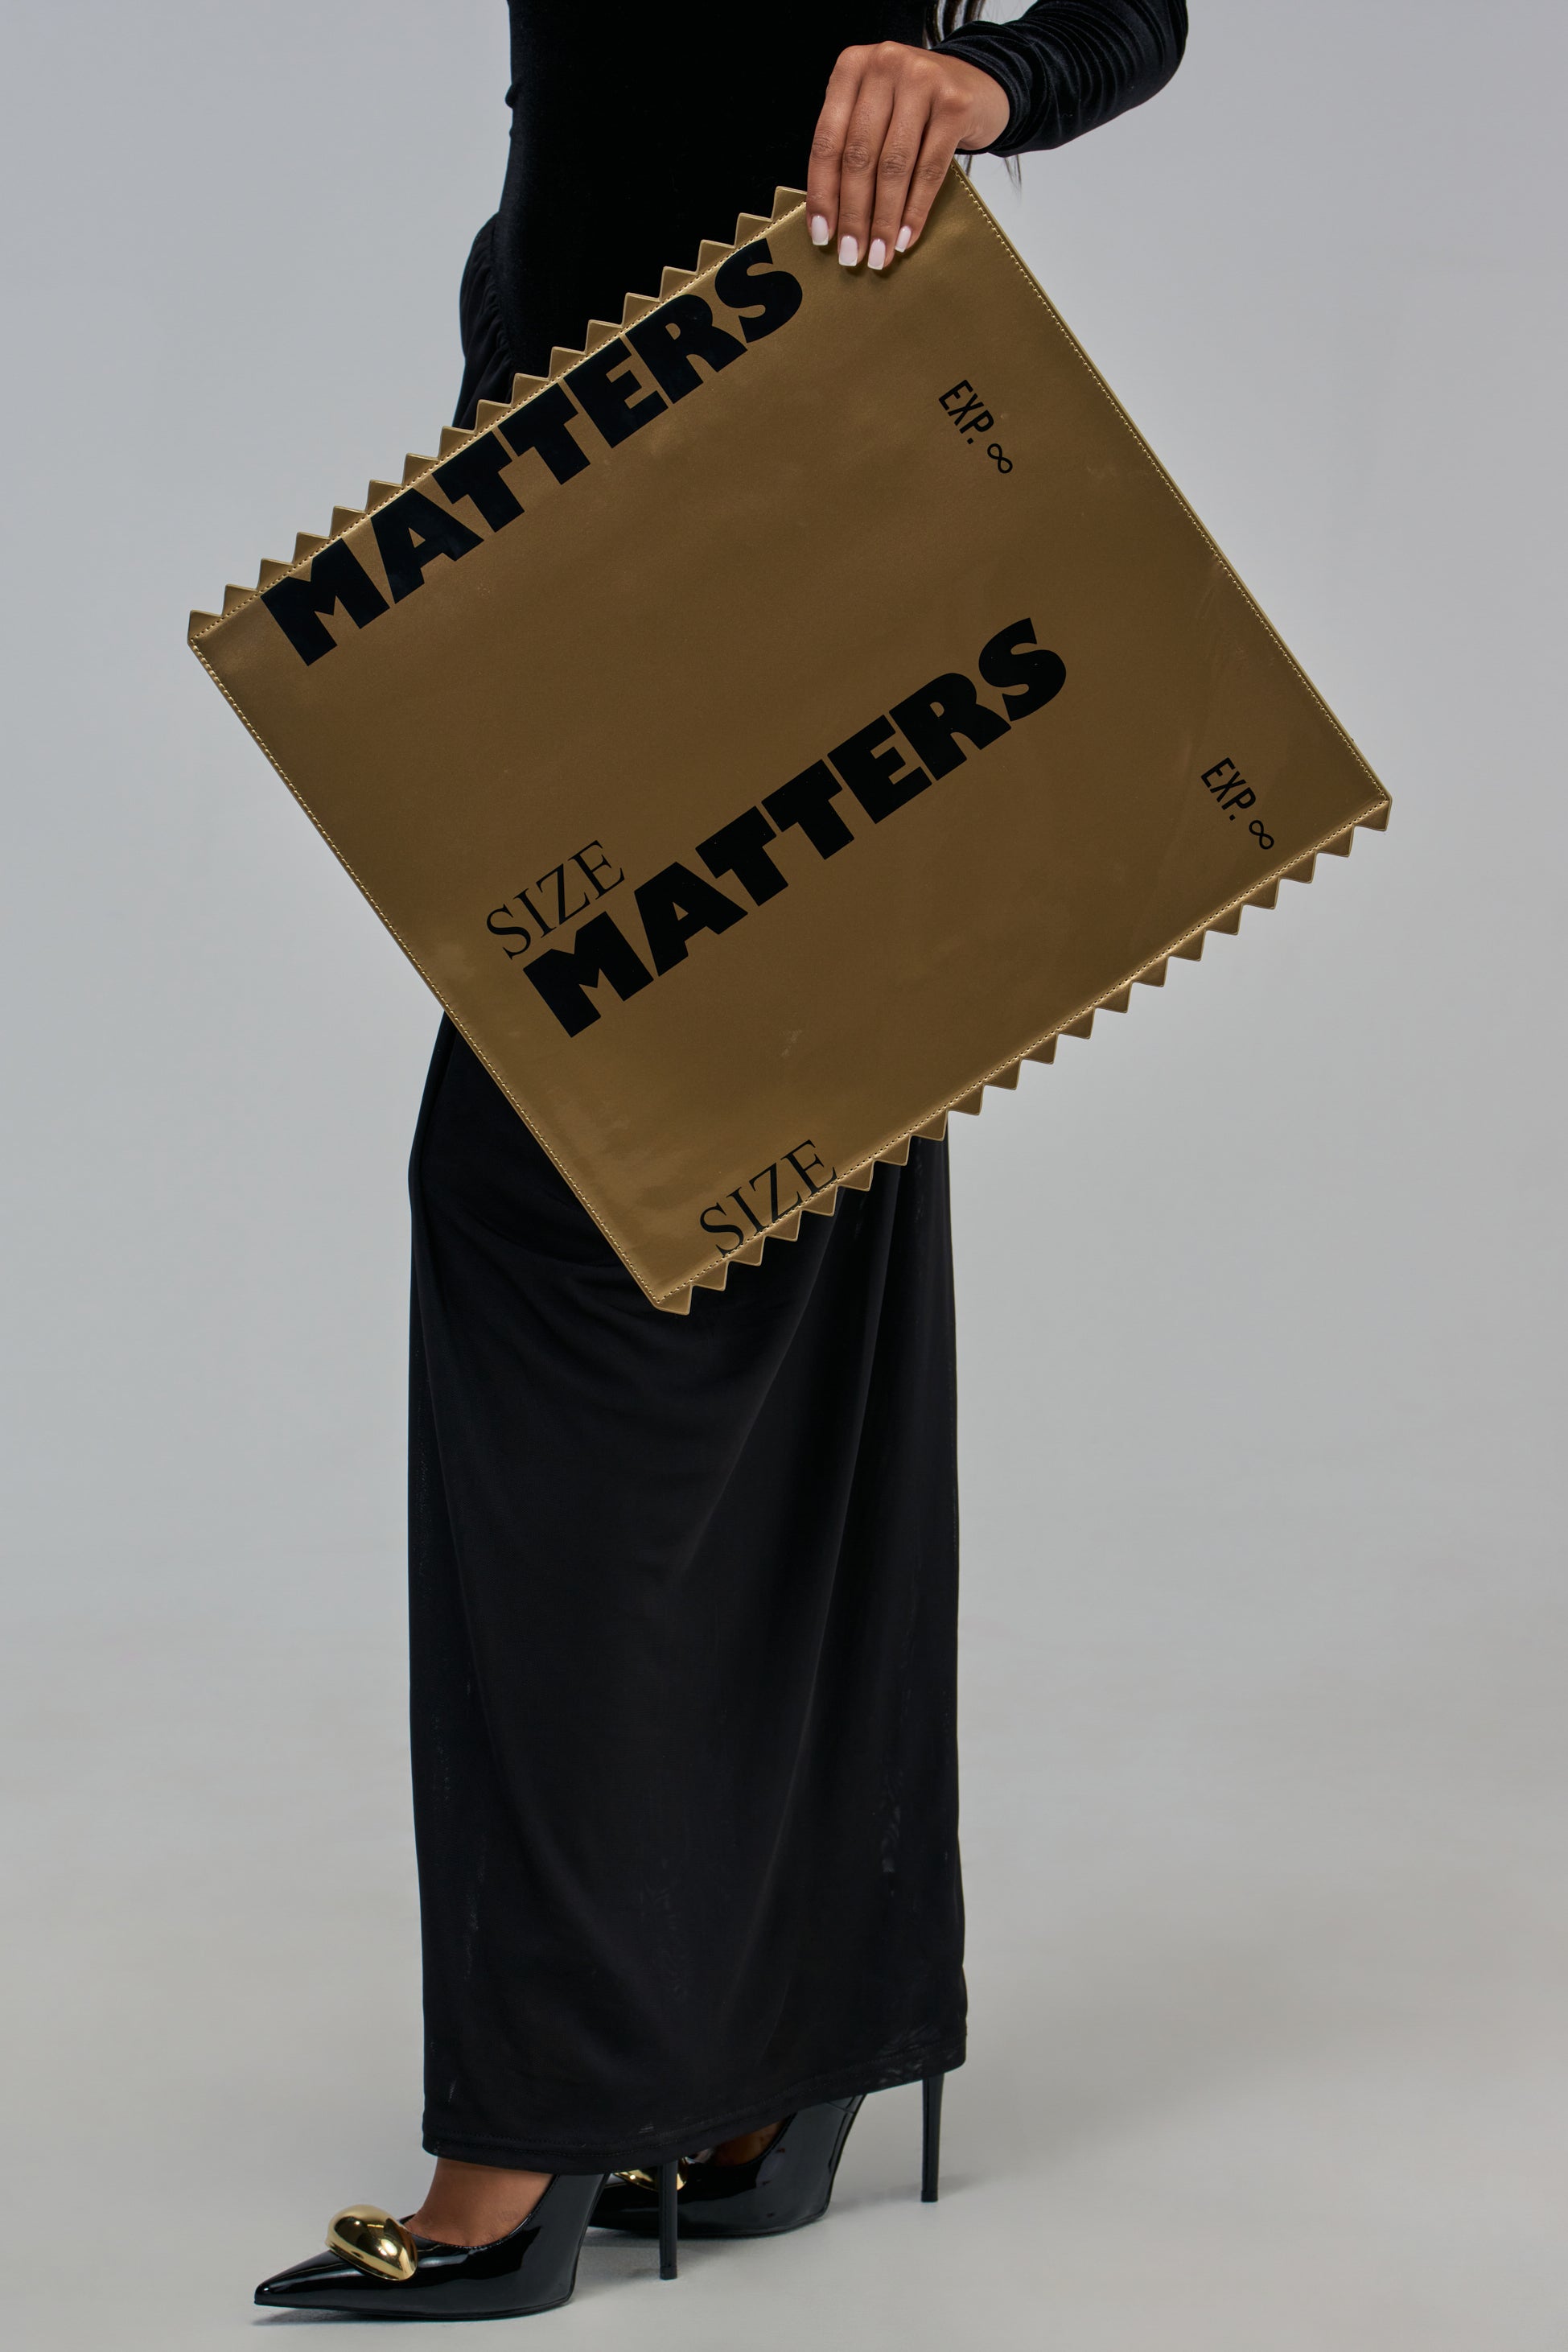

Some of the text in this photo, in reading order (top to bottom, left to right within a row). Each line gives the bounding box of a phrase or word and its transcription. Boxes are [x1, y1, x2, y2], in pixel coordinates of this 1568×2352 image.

[260, 238, 804, 666] MATTERS
[939, 380, 994, 444] EXP.
[523, 618, 1067, 1038] MATTERS
[1201, 758, 1257, 821] EXP.
[486, 841, 625, 959] SIZE
[699, 1139, 838, 1257] SIZE
